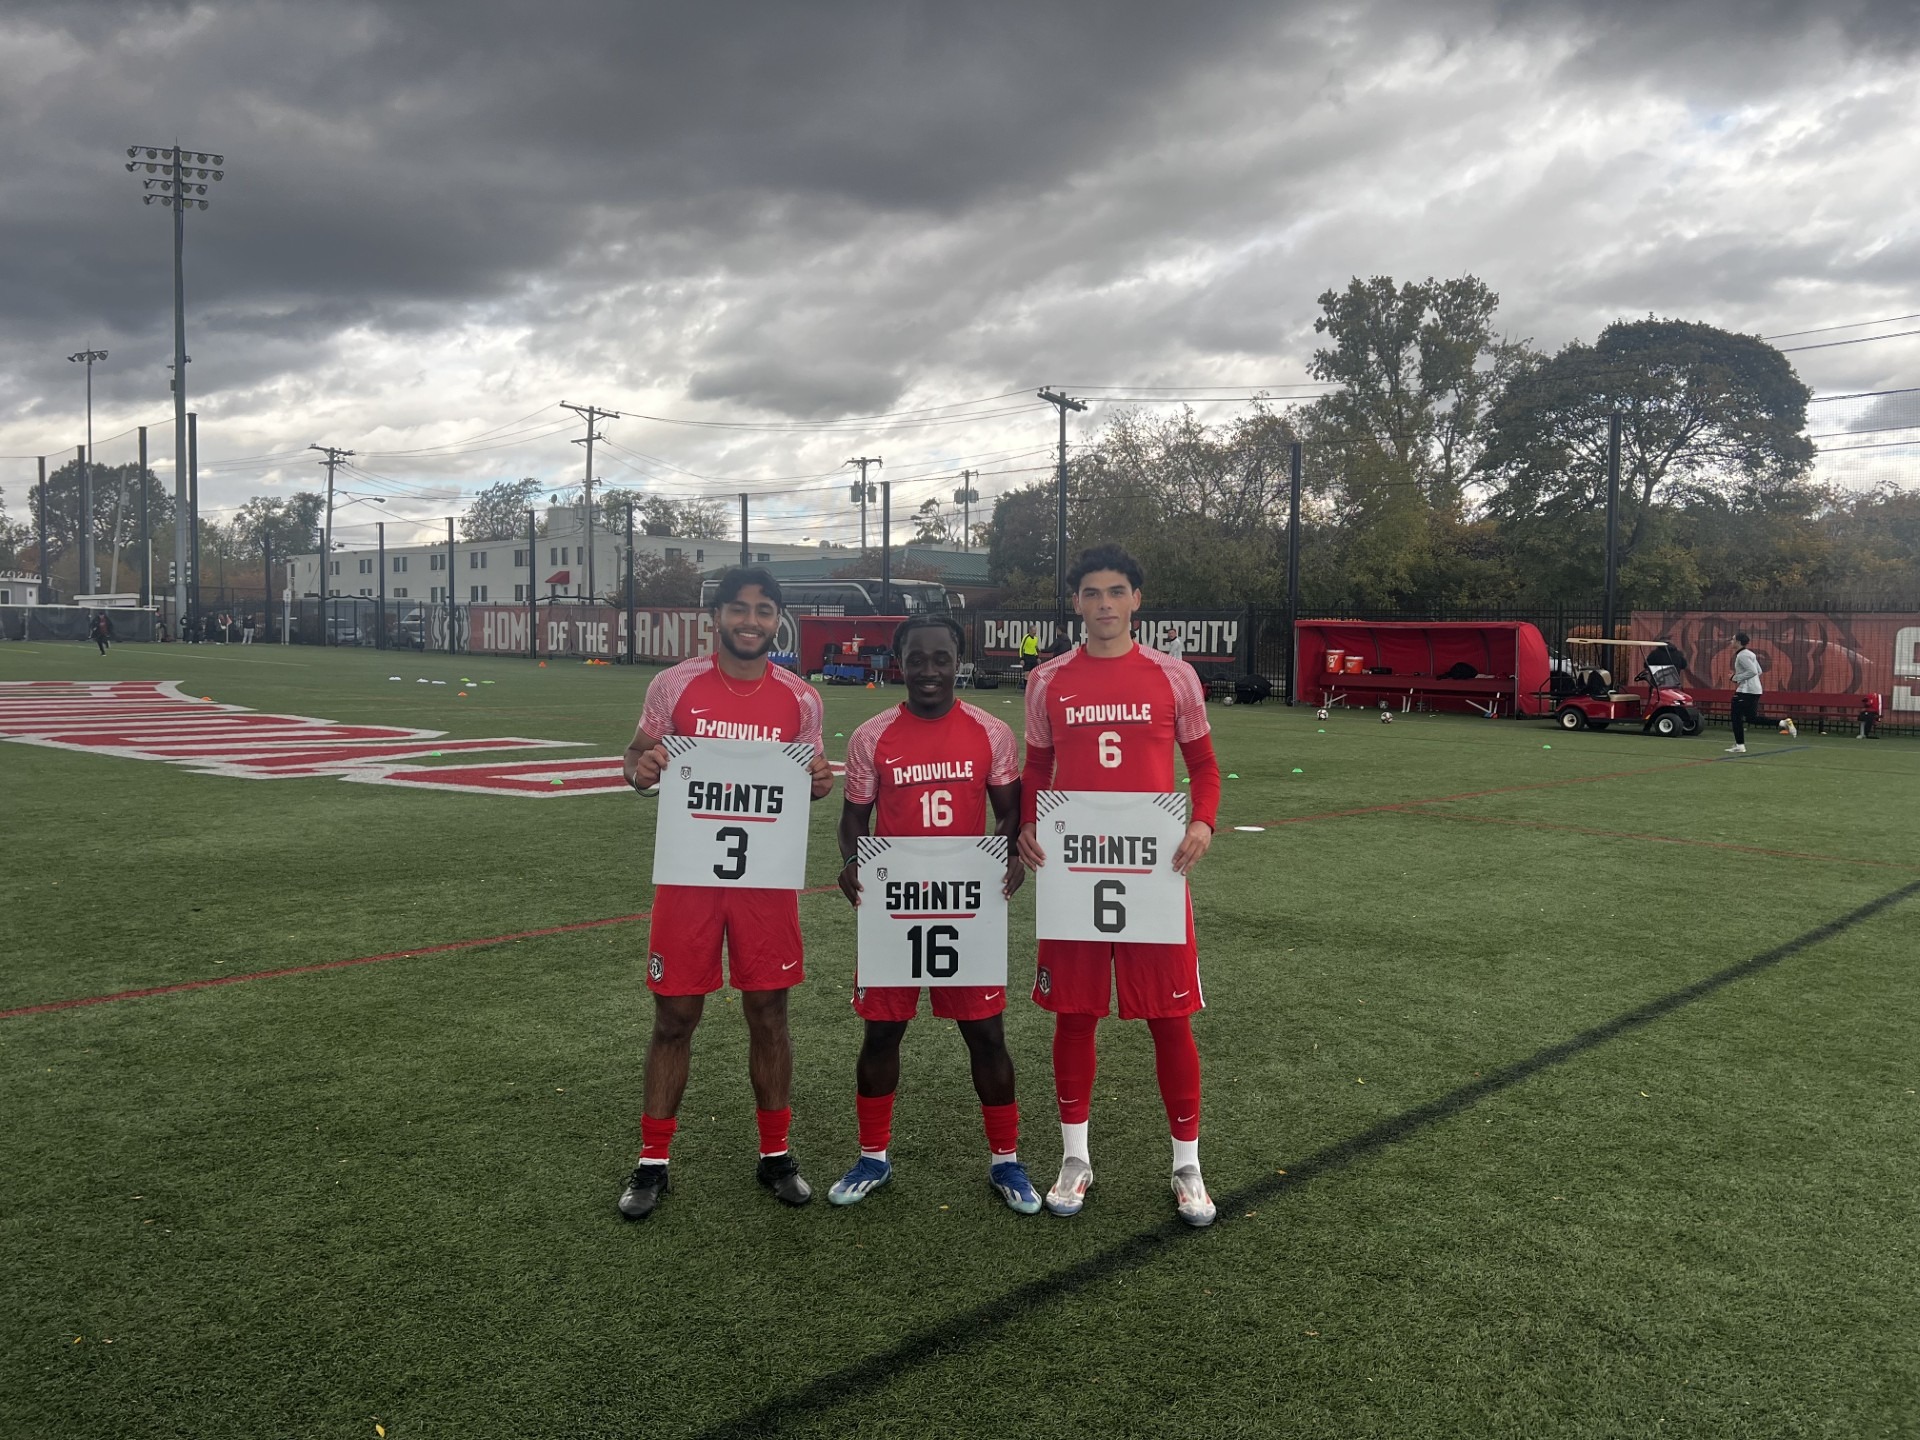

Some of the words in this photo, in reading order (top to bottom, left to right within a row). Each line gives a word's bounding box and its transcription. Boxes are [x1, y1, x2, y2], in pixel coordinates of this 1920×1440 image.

[547, 621, 568, 650] OF
[575, 621, 609, 654] THE
[1098, 731, 1122, 768] 6
[919, 789, 953, 828] 16
[713, 826, 749, 880] 3
[1093, 879, 1126, 933] 6
[907, 925, 959, 979] 16
